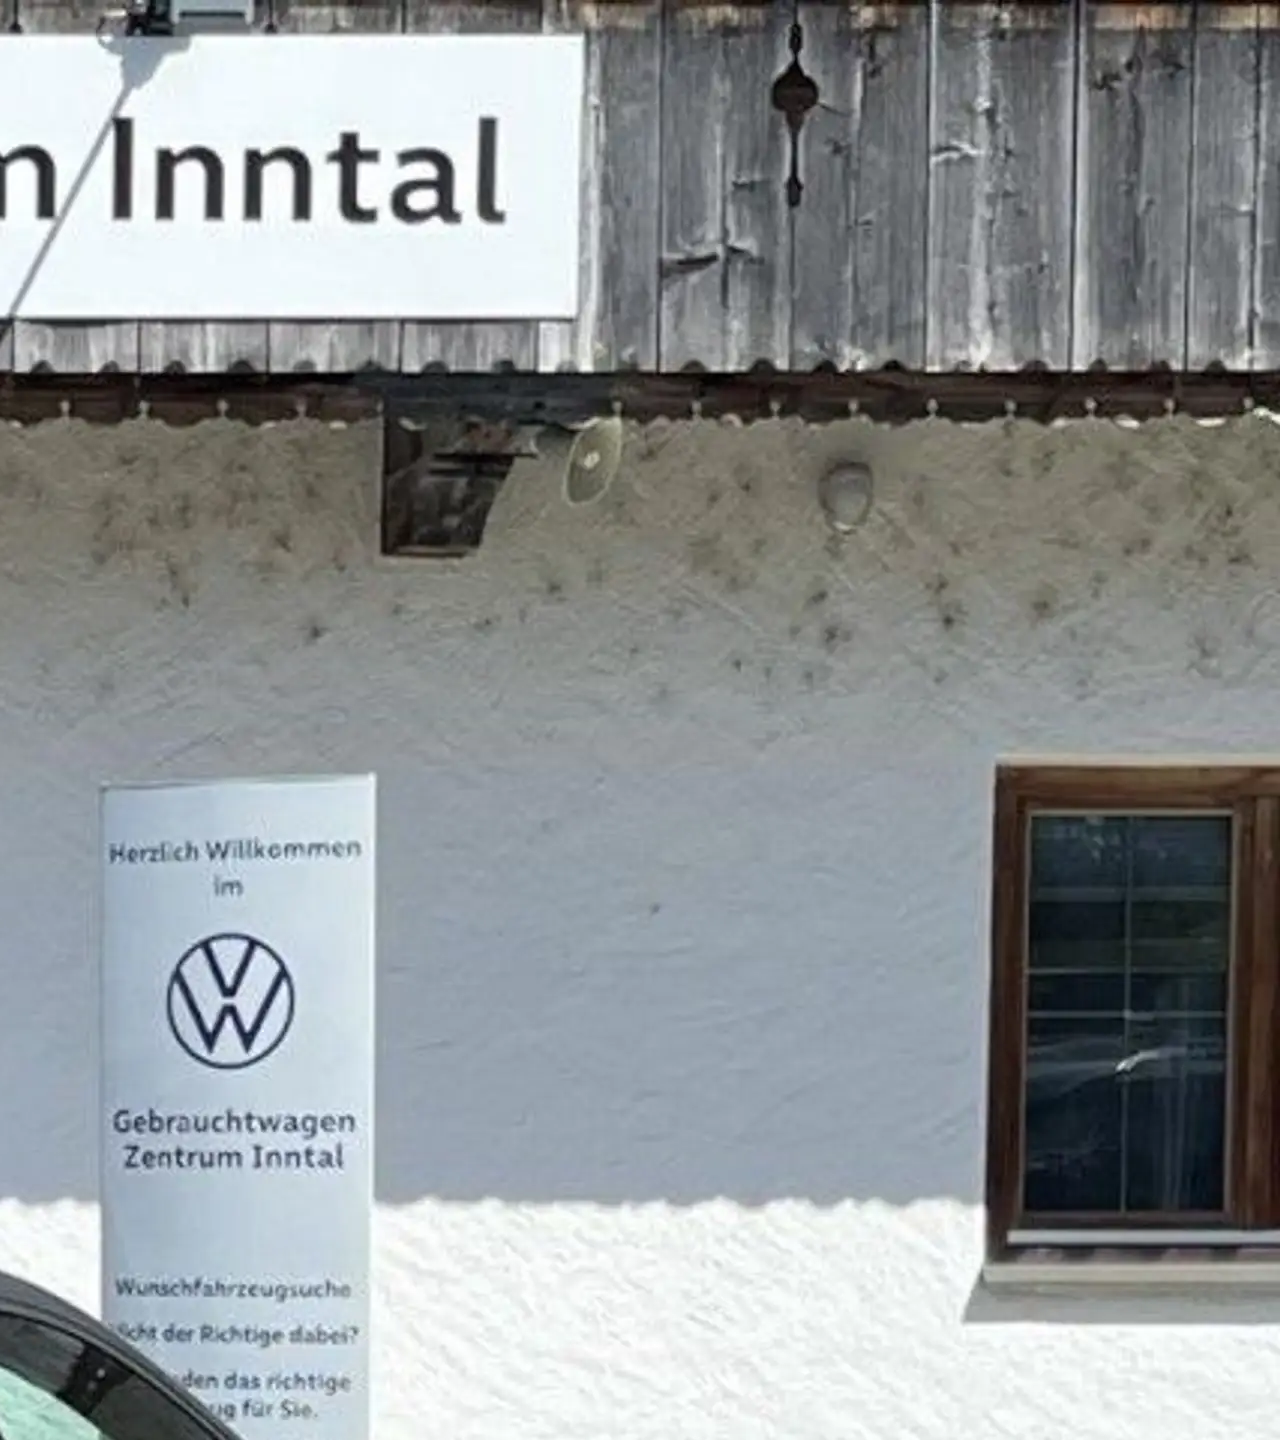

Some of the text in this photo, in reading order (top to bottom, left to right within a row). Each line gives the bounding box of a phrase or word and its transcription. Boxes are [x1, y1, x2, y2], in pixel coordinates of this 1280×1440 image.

[111, 115, 506, 224] Inntal
[109, 838, 362, 863] Herzlich Willkommen
[214, 876, 244, 896] im
[113, 1108, 356, 1138] Gebrauchtwagen
[124, 1143, 344, 1168] Zentrum Inntal
[115, 1278, 352, 1303] Wunschfahrzeugsuche
[162, 1324, 194, 1342] der
[200, 1324, 285, 1347] Richtige
[290, 1325, 359, 1344] dabei?
[224, 1371, 261, 1389] das
[268, 1372, 351, 1396] richtige
[243, 1398, 273, 1417] für
[280, 1400, 318, 1419] Sie.
